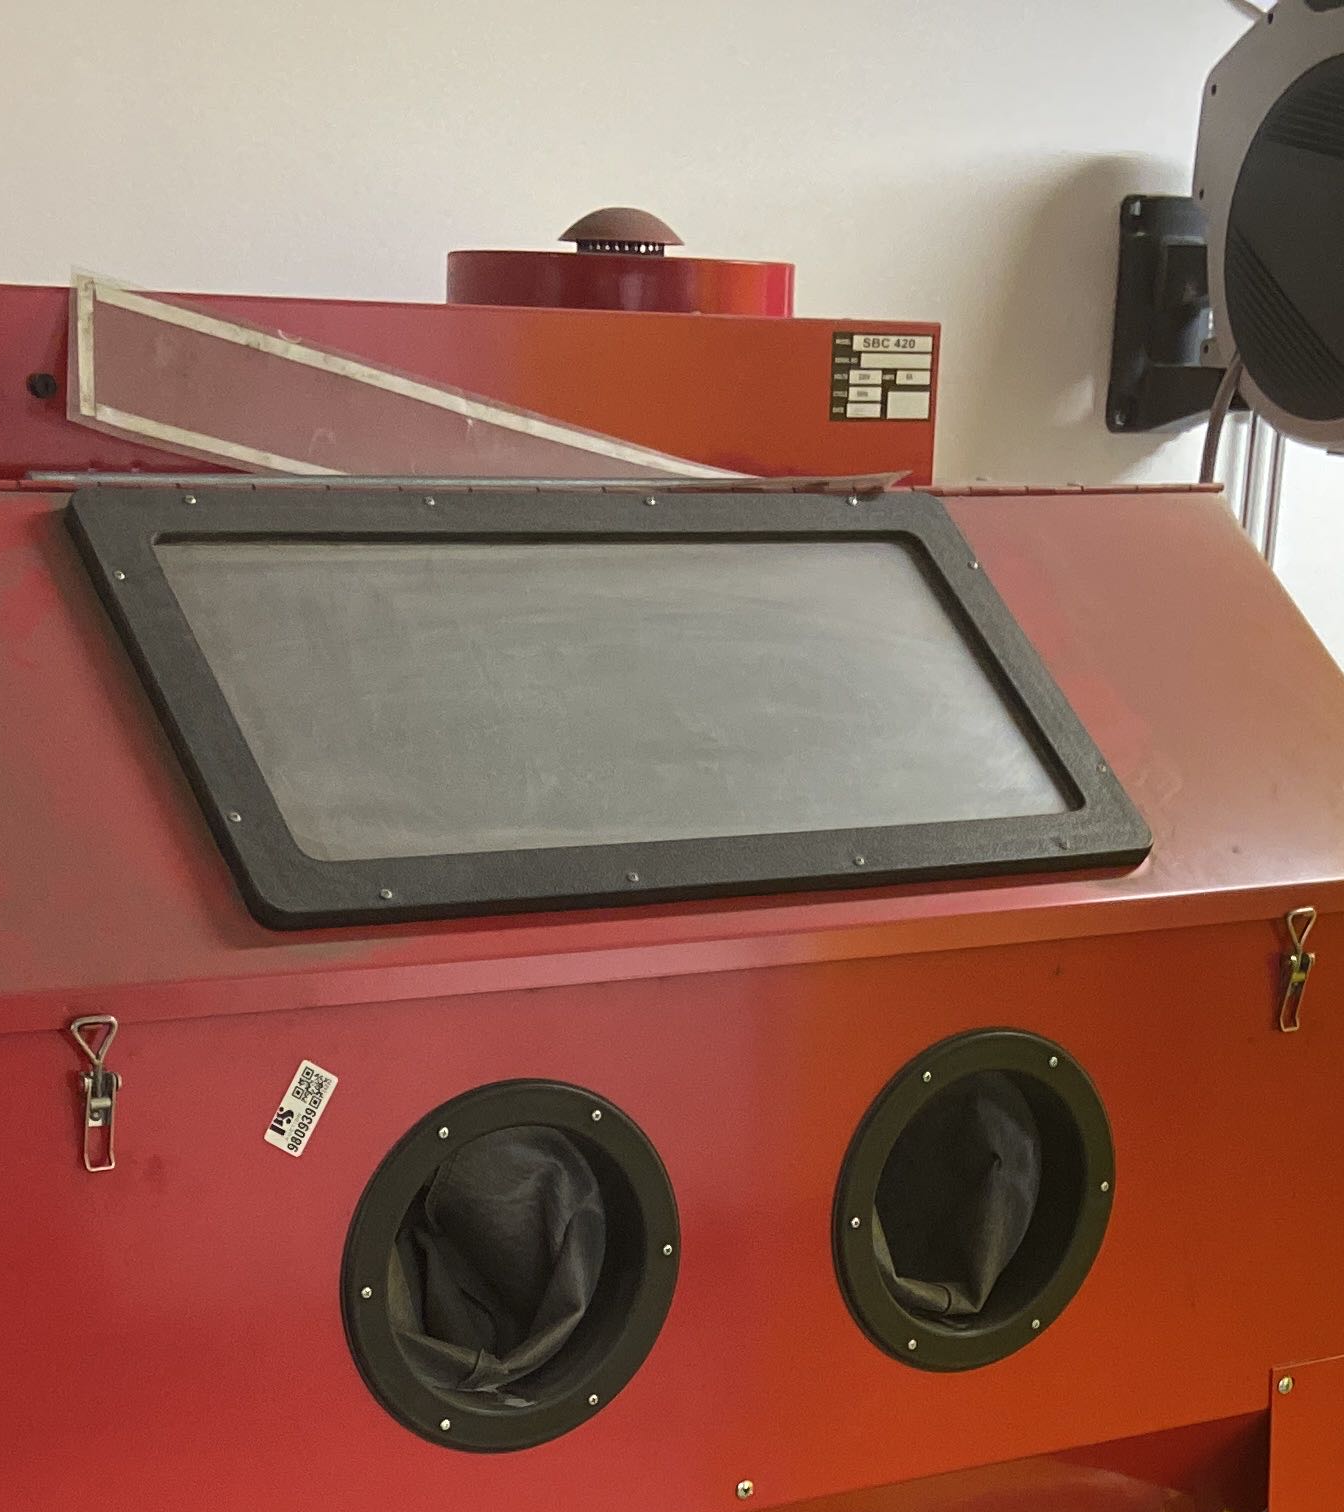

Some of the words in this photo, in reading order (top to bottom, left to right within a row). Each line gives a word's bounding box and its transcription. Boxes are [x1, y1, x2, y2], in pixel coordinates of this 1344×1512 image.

[862, 338, 890, 349] SBC
[894, 339, 916, 349] 420
[287, 1107, 317, 1153] 980939
